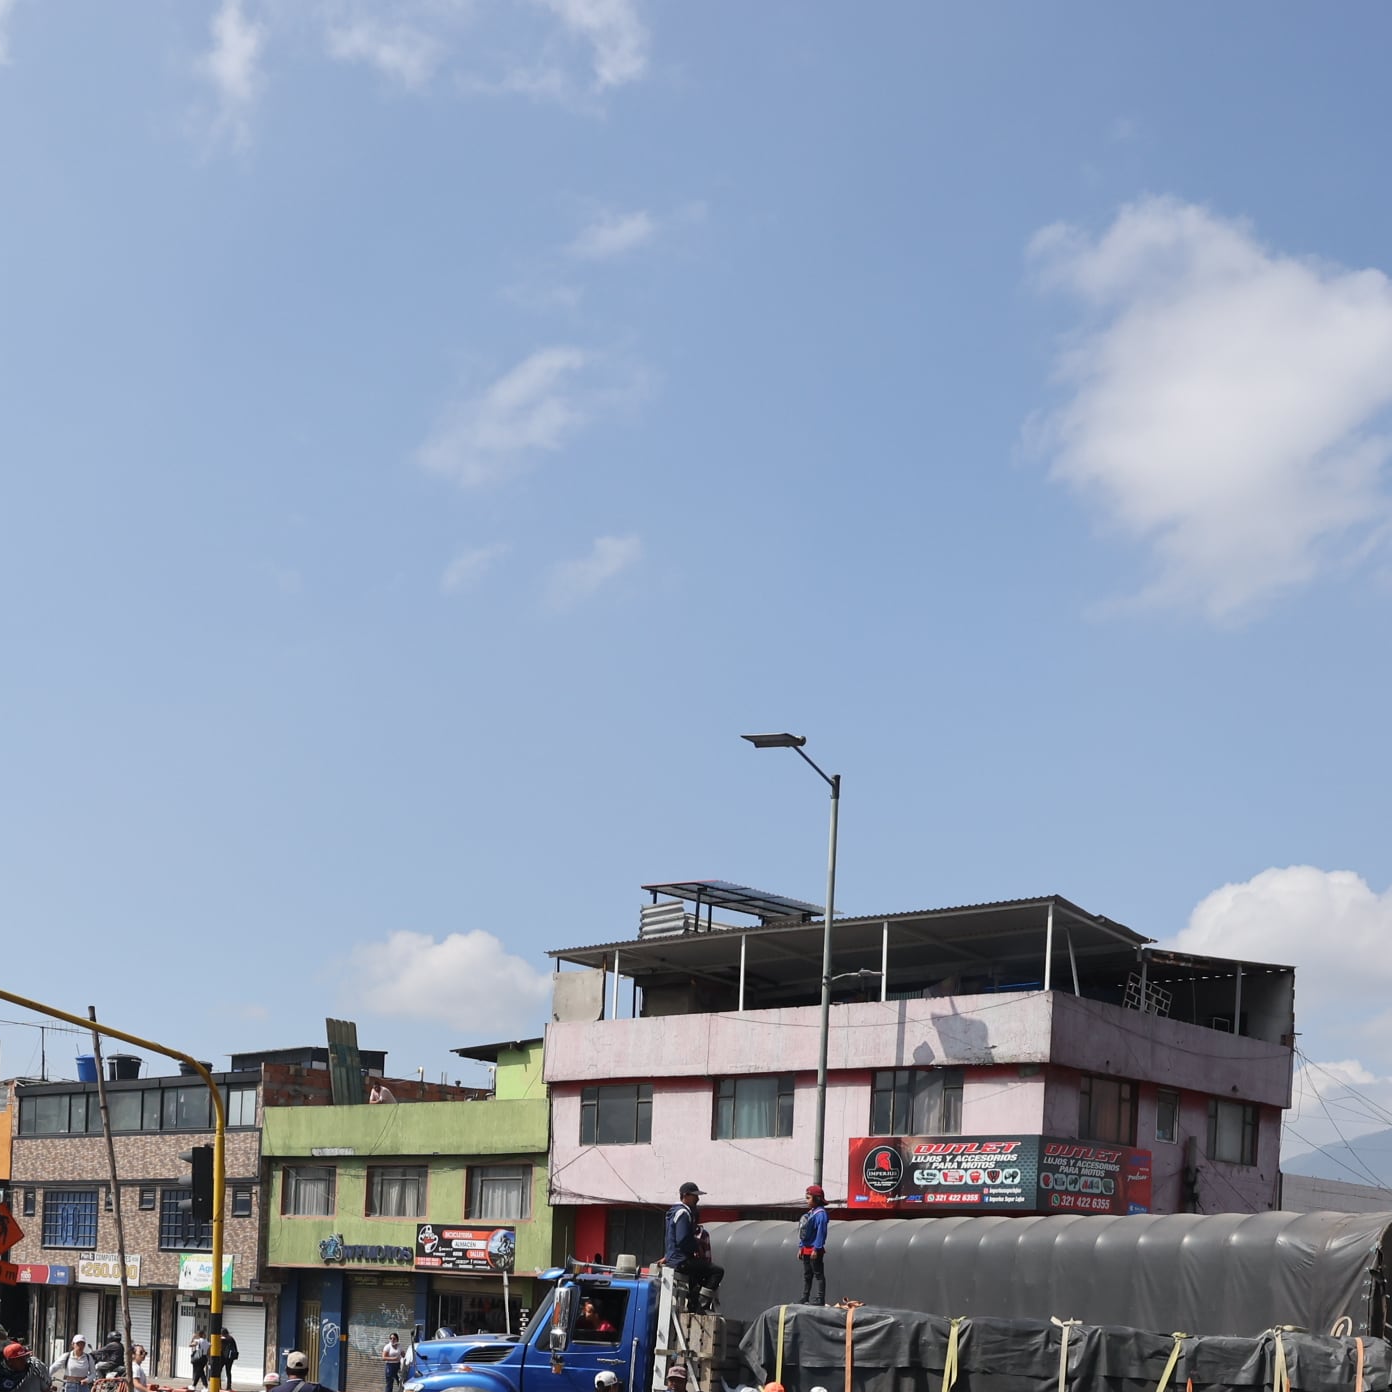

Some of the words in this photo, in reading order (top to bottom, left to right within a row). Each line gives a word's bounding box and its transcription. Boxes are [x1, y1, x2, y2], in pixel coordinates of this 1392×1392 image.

[913, 1141, 1022, 1155] OUTLET
[1044, 1143, 1122, 1163] OUTLET
[911, 1155, 942, 1163] LUJOS
[945, 1155, 953, 1163] Y
[954, 1153, 1018, 1163] ACCESORIOS
[960, 1161, 996, 1169] MOTOS
[1043, 1157, 1068, 1165] LUJOS
[1069, 1159, 1076, 1167] Y
[1076, 1160, 1120, 1172] ACCESORIOS
[1059, 1165, 1079, 1174] PARA
[1080, 1168, 1106, 1177] MOTOS
[935, 1194, 947, 1202] 321
[948, 1194, 961, 1202] 422
[963, 1193, 979, 1202] 6355
[1061, 1195, 1074, 1206] 321
[1077, 1196, 1091, 1208] 422
[1092, 1197, 1111, 1210] 6355
[5, 1270, 16, 1281] m
